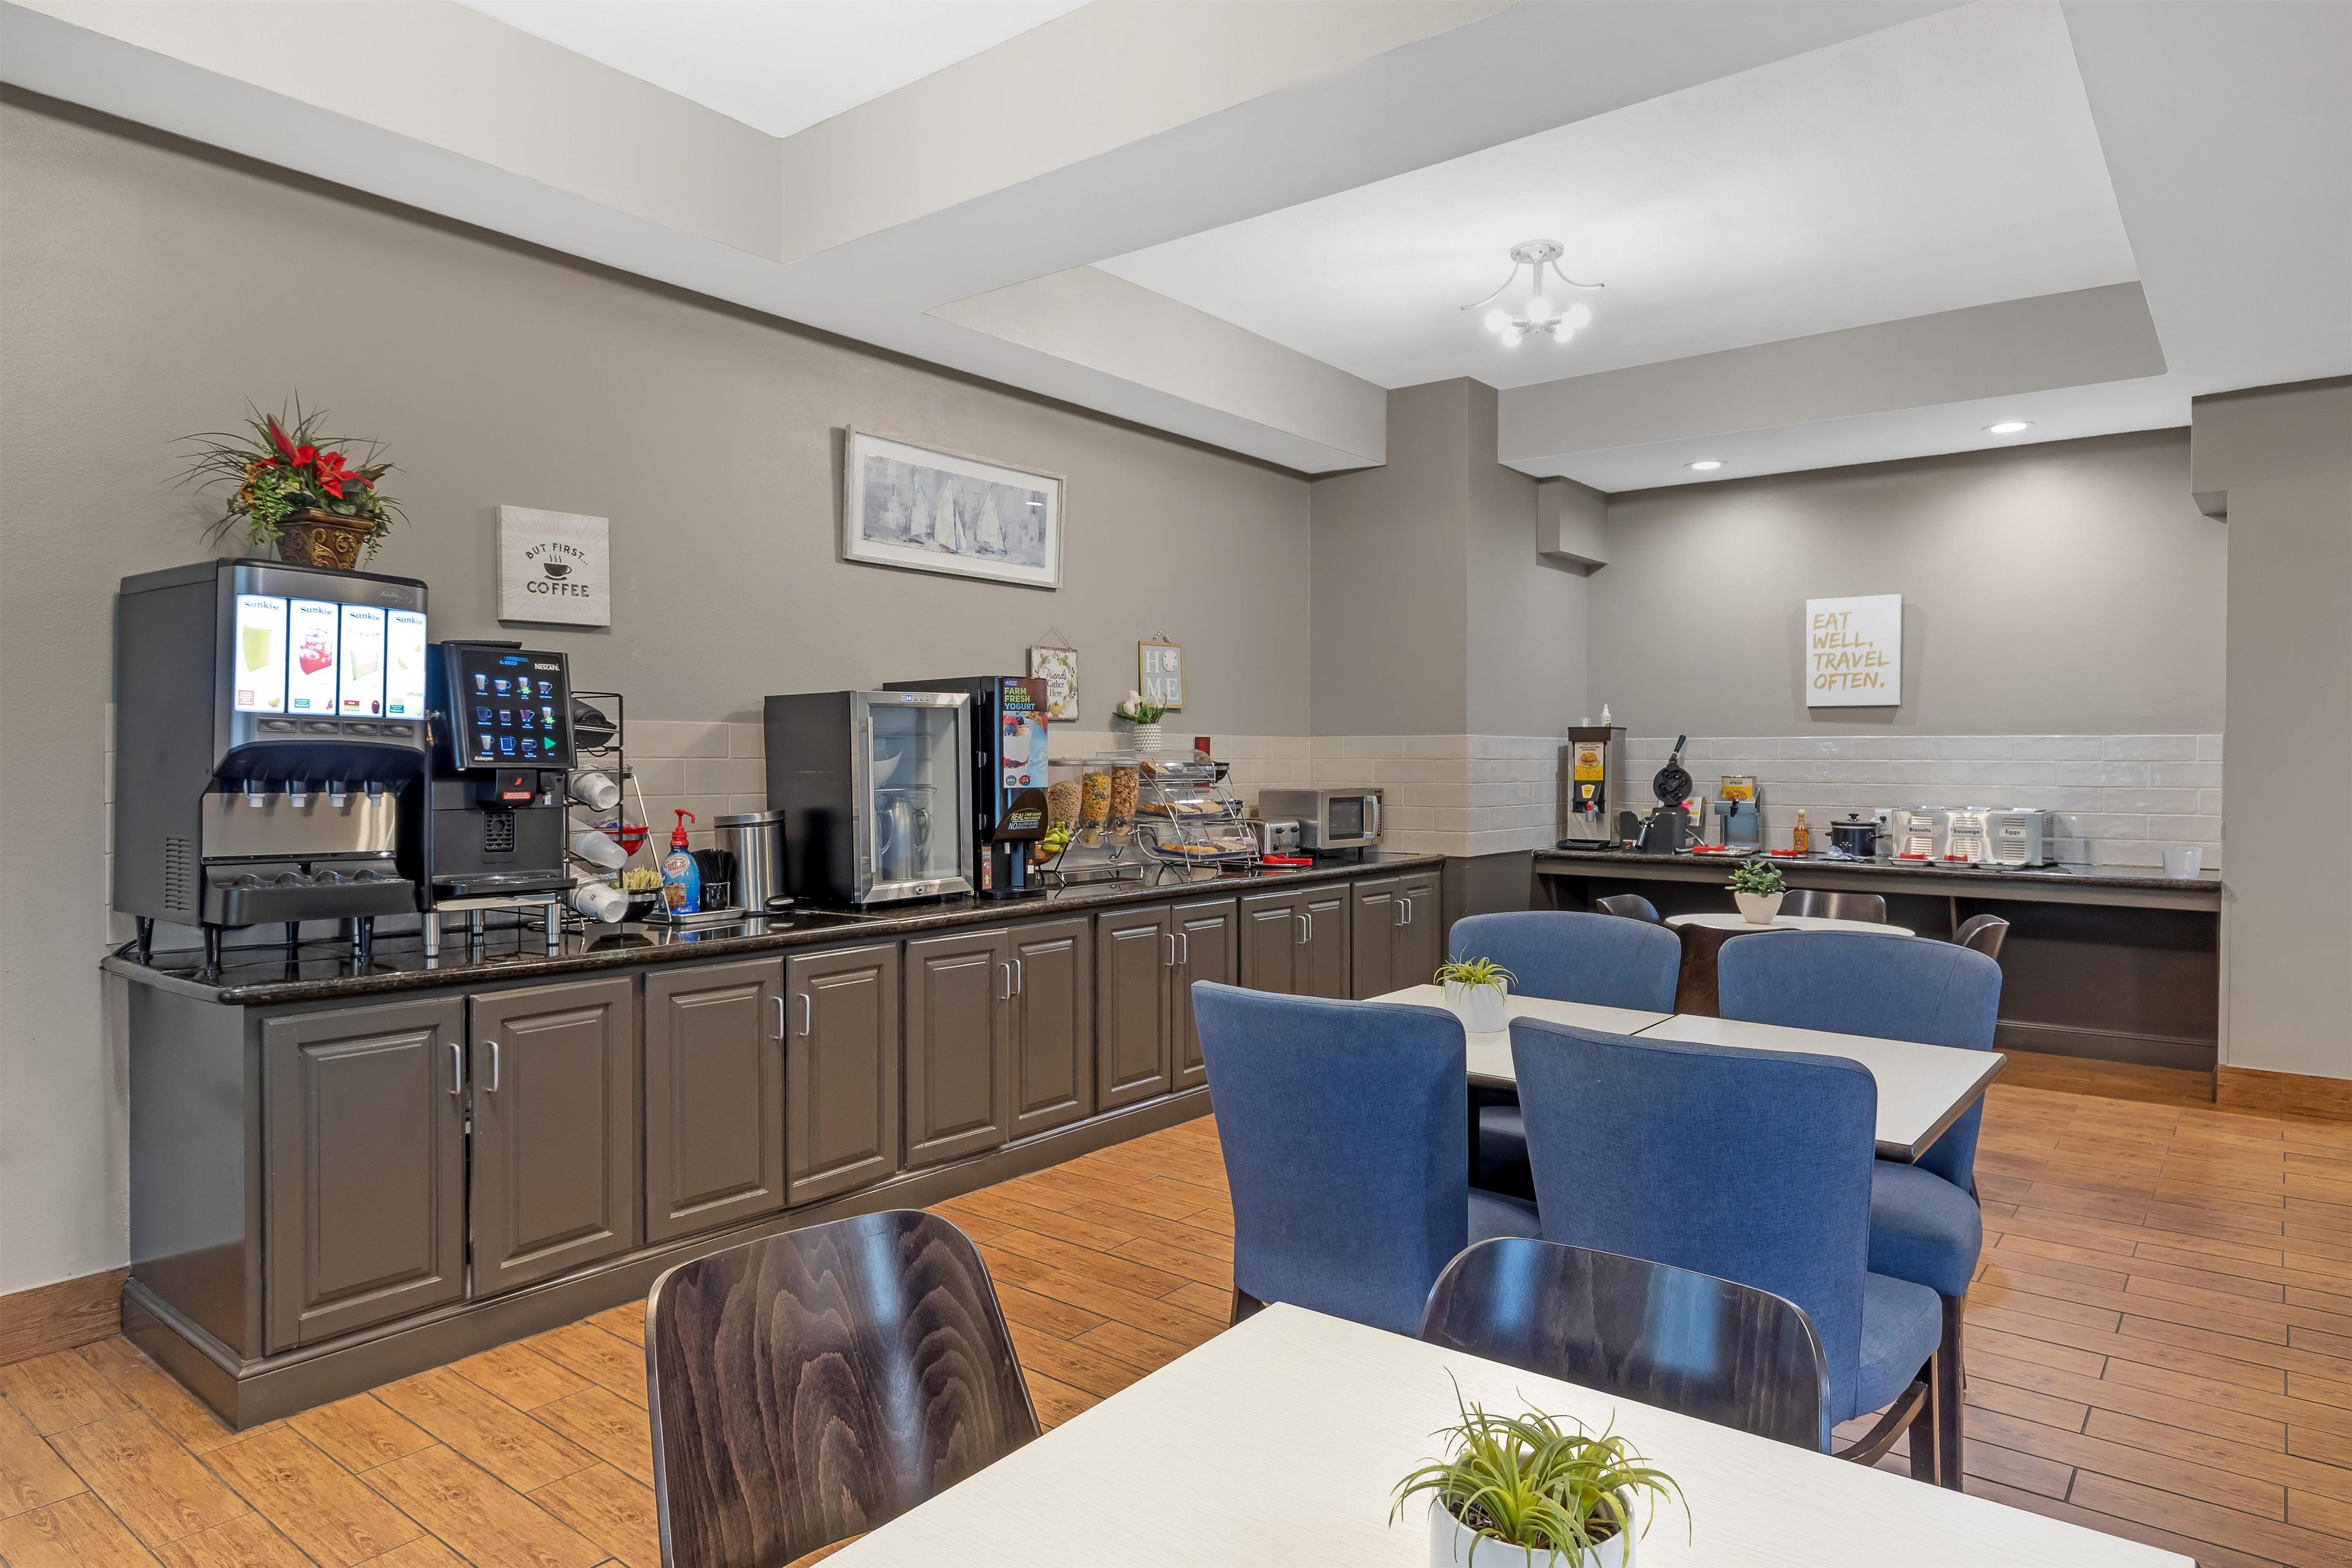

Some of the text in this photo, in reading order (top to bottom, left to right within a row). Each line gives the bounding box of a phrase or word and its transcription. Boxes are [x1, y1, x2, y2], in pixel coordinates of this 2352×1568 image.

[525, 543, 588, 565] BUT FIRST...
[527, 581, 589, 597] COFFEE
[1812, 612, 1853, 631] EAT
[1812, 631, 1873, 649] WELL,
[1812, 650, 1891, 671] TRAVEL
[1042, 666, 1068, 680] Friends
[1813, 672, 1885, 691] OFTEN.
[1047, 679, 1065, 688] Gather
[1049, 688, 1063, 697] Here
